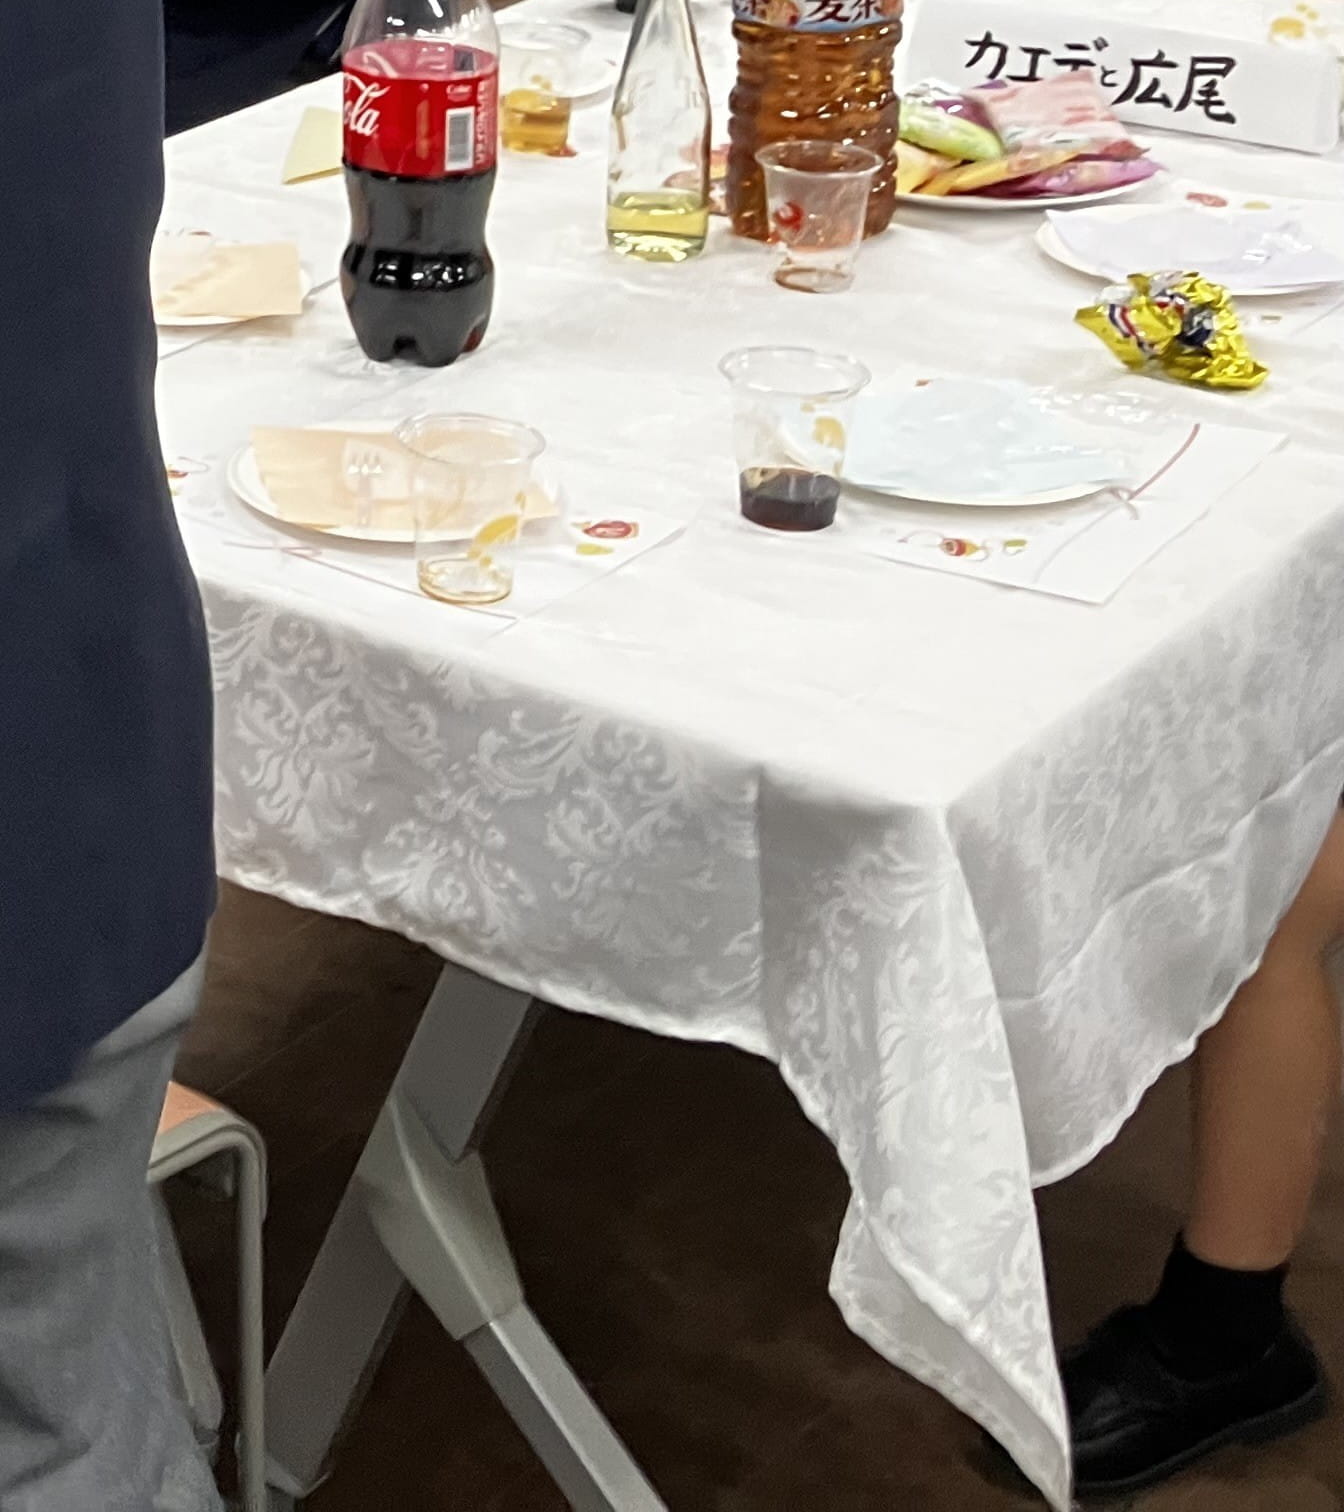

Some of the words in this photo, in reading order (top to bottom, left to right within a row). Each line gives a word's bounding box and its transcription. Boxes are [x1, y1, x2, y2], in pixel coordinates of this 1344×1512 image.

[344, 72, 391, 136] ola
[964, 30, 1237, 125] カエデと広尾
